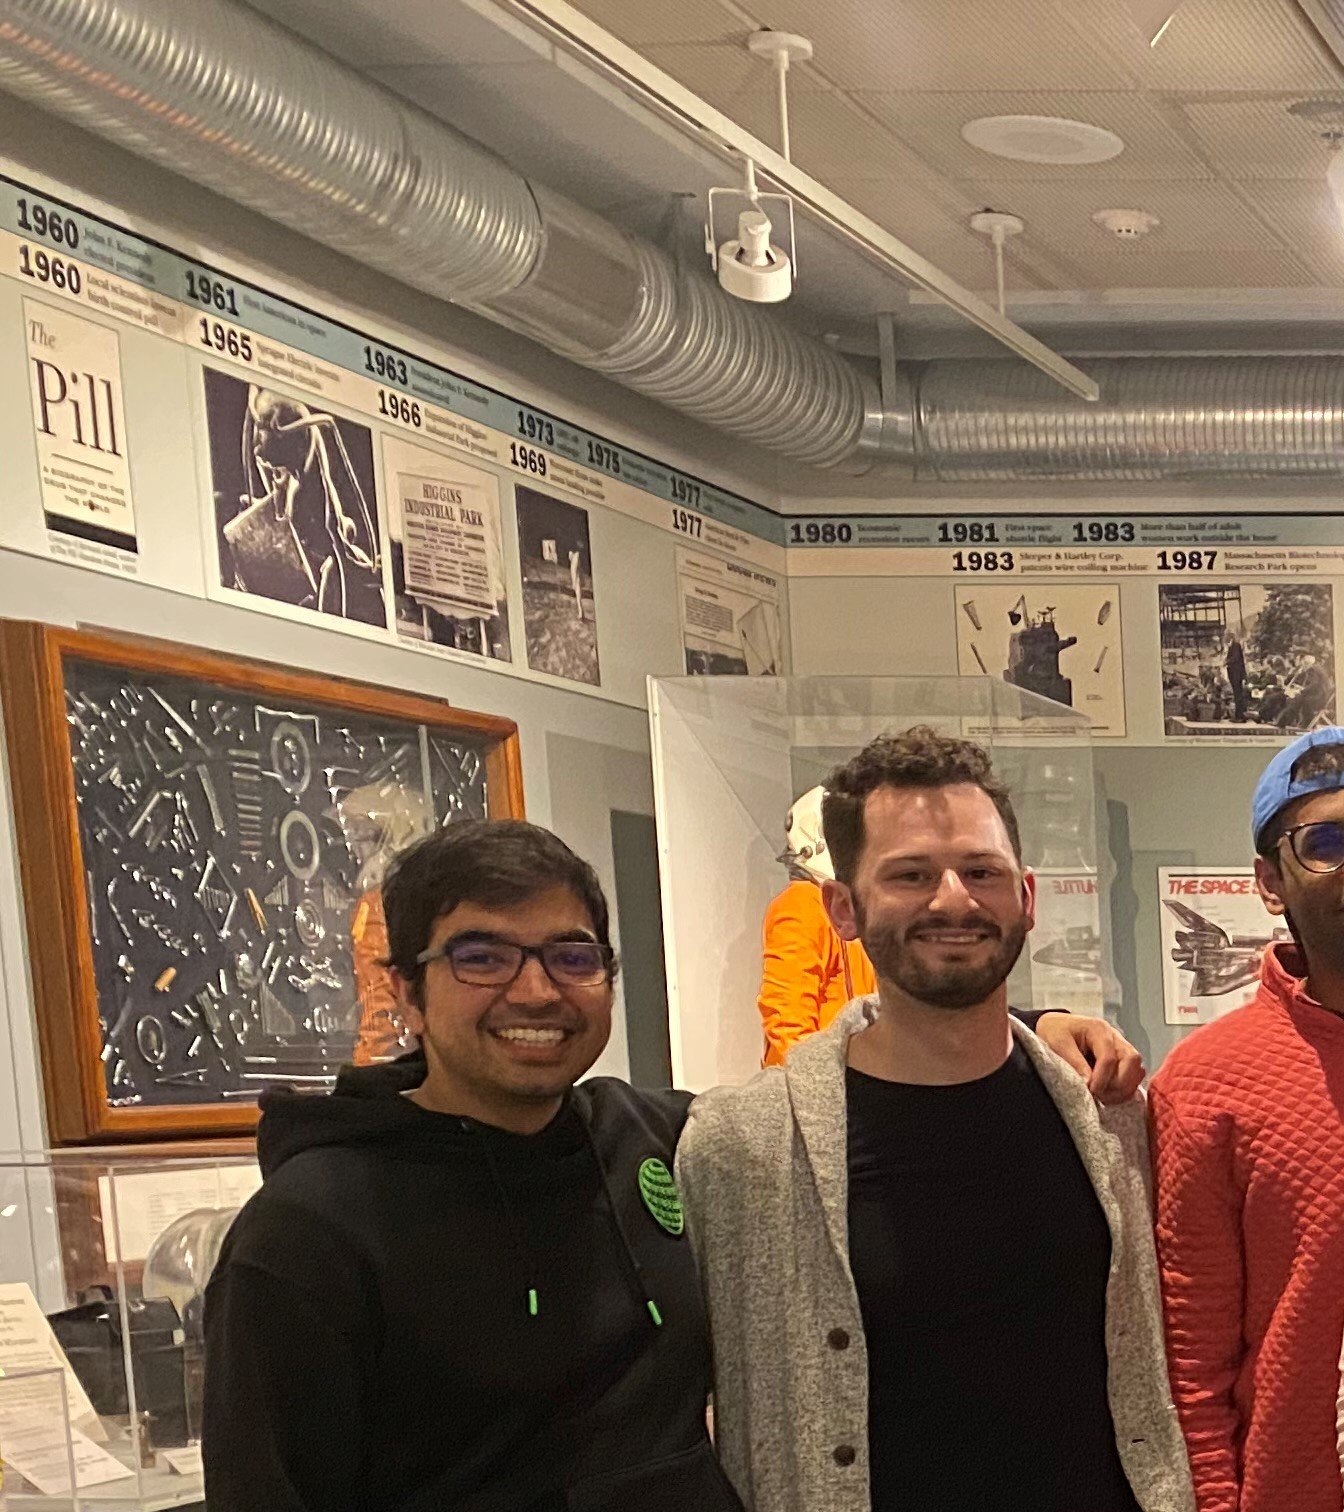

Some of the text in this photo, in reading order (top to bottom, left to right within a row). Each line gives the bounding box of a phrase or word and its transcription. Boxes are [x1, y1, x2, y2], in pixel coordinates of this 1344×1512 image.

[17, 198, 79, 249] 1960
[18, 244, 81, 294] 1960
[185, 269, 239, 317] 1961
[29, 319, 56, 348] The
[199, 317, 252, 362] 1965
[363, 345, 408, 385] 1963
[31, 357, 122, 457] Pill
[378, 389, 421, 427] 1966
[518, 410, 554, 445] 1973
[510, 442, 546, 476] 1969
[587, 440, 620, 473] 1975
[422, 483, 462, 504] HIGGINS
[670, 473, 700, 508] 1977
[404, 498, 484, 527] INDUSTRIAL PARK
[672, 509, 702, 538] 1977
[790, 522, 852, 543] 1980
[938, 522, 999, 543] 1981
[1072, 522, 1135, 542] 1983
[952, 551, 1014, 571] 1983
[1021, 564, 1053, 573] patents
[1110, 563, 1150, 571] machine
[1099, 553, 1123, 562] Corp.
[1157, 550, 1218, 570] 1987
[1224, 563, 1317, 573] Research Park opens
[1168, 880, 1199, 895] THE
[1200, 880, 1250, 894] SPACE
